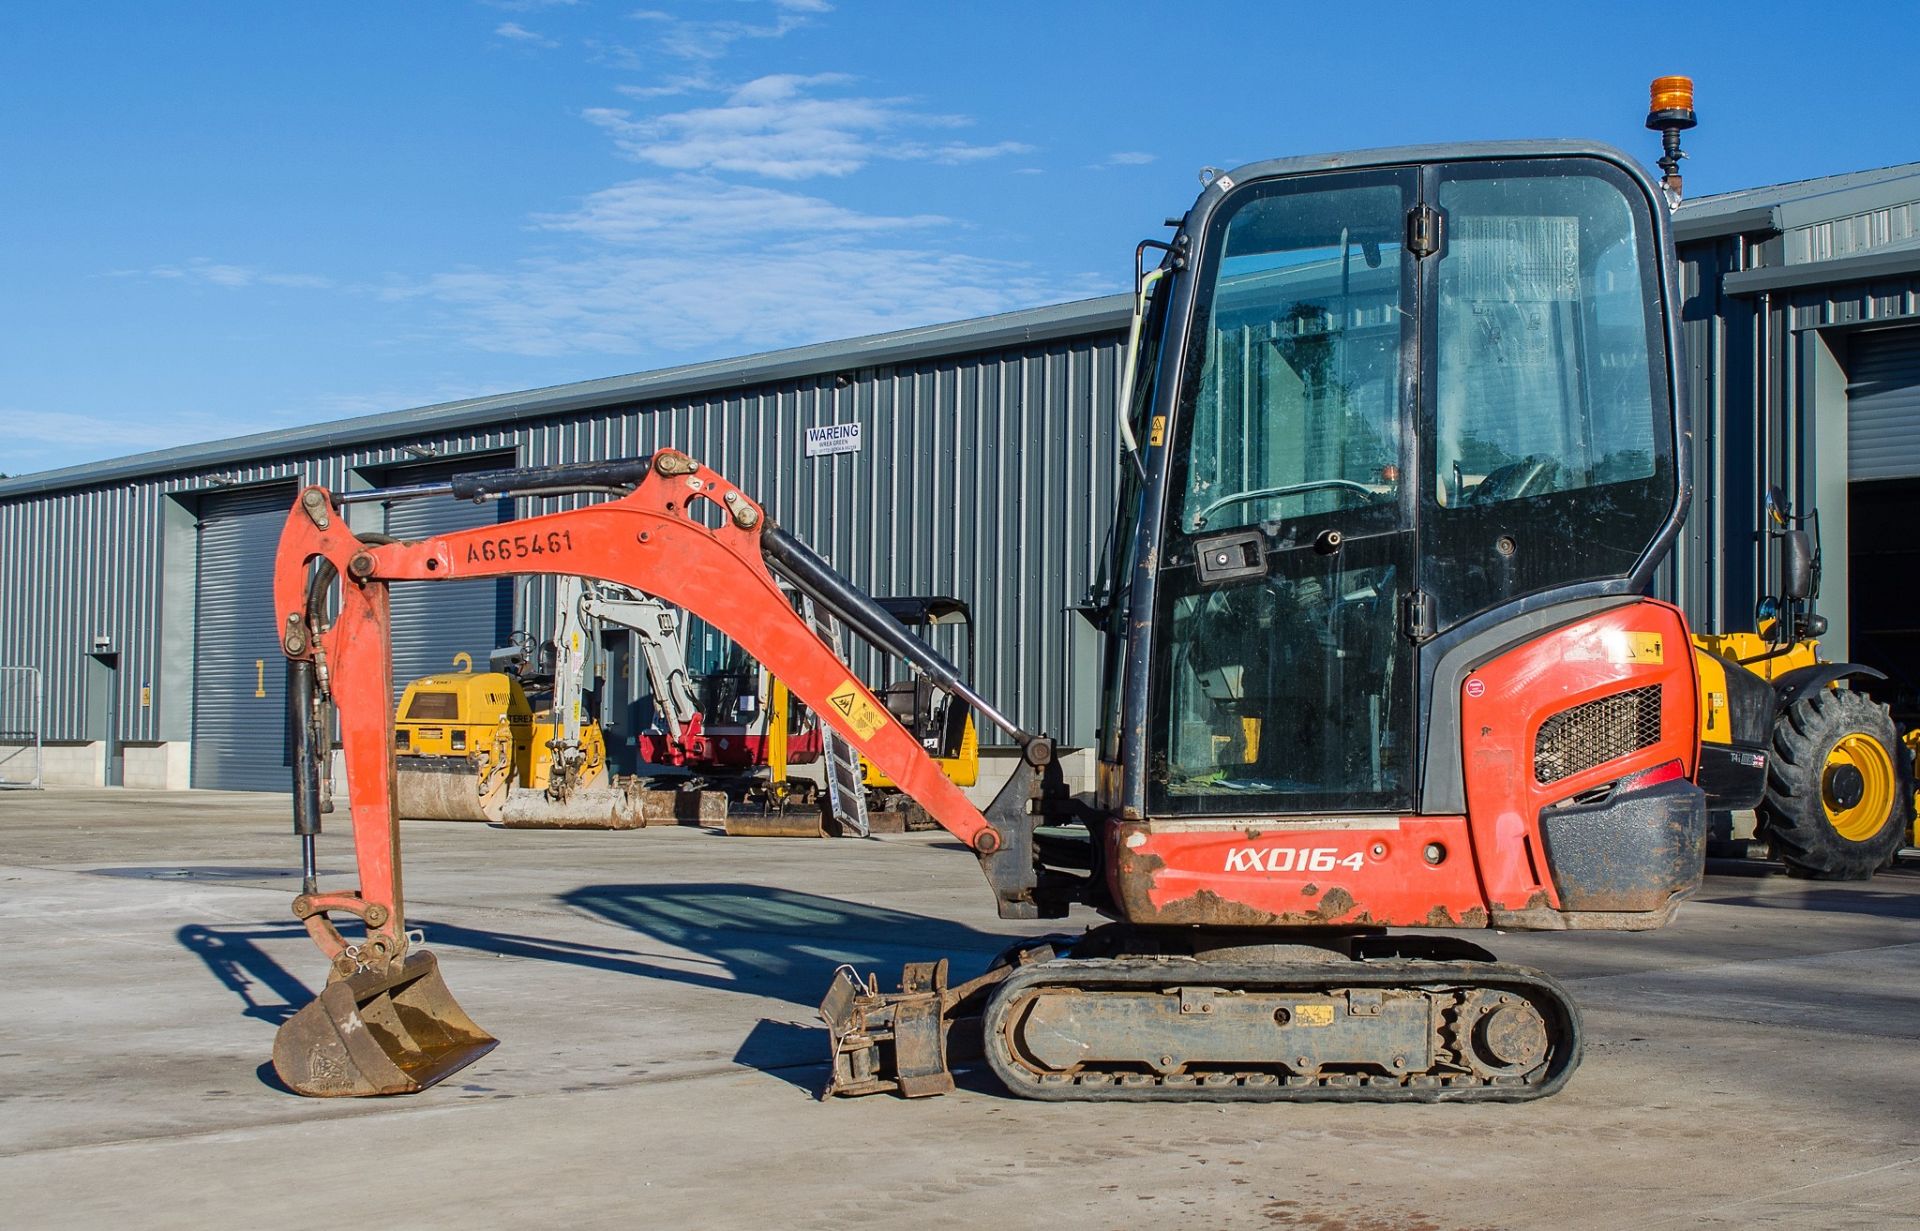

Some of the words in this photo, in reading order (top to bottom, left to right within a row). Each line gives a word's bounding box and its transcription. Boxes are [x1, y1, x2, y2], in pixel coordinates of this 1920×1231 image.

[810, 425, 858, 441] WAREING
[468, 530, 572, 563] A665461
[255, 659, 266, 698] 1
[509, 714, 533, 723] TEREX
[1224, 847, 1364, 872] KX016-4
